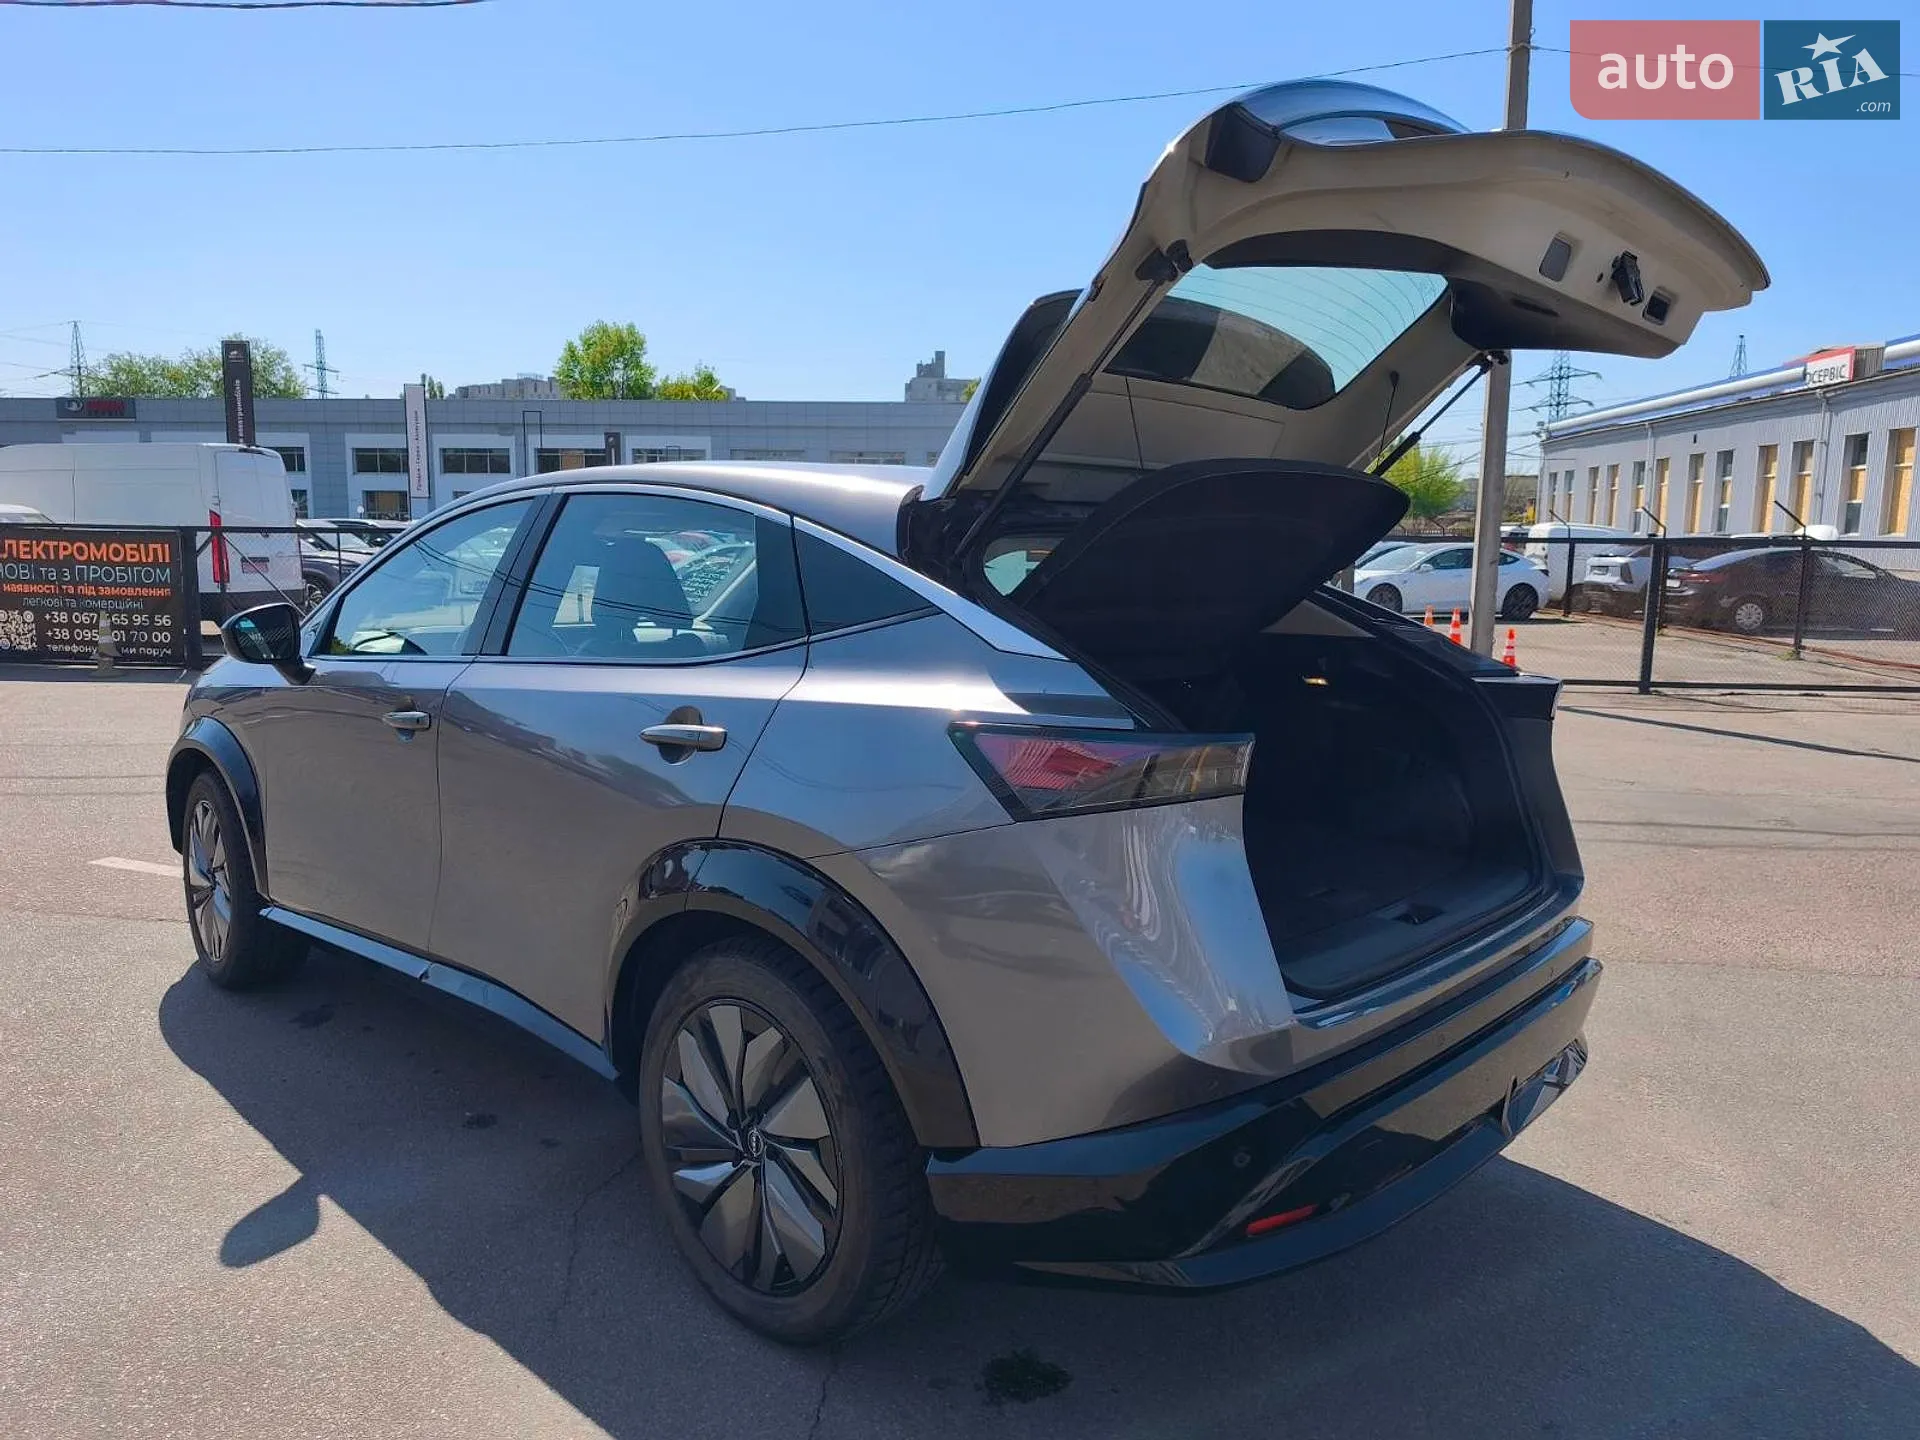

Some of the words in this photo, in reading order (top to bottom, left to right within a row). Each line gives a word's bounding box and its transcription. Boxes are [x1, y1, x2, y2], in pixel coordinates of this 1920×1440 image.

[0, 539, 171, 563] ЛЕКТРОМОБІЛІ
[40, 568, 57, 581] та
[61, 568, 71, 581] з
[75, 565, 171, 584] ПРОБІГОМ
[3, 582, 59, 594] наявності
[61, 584, 75, 594] та
[77, 583, 96, 596] під
[44, 611, 68, 624] +38
[72, 612, 98, 624] 067
[105, 613, 129, 625] 65
[132, 614, 150, 626] 95
[154, 614, 172, 627] 56
[45, 628, 70, 640] +38
[74, 628, 100, 641] 095
[129, 631, 148, 642] 70
[152, 631, 171, 643] 00
[46, 643, 98, 655] телефону
